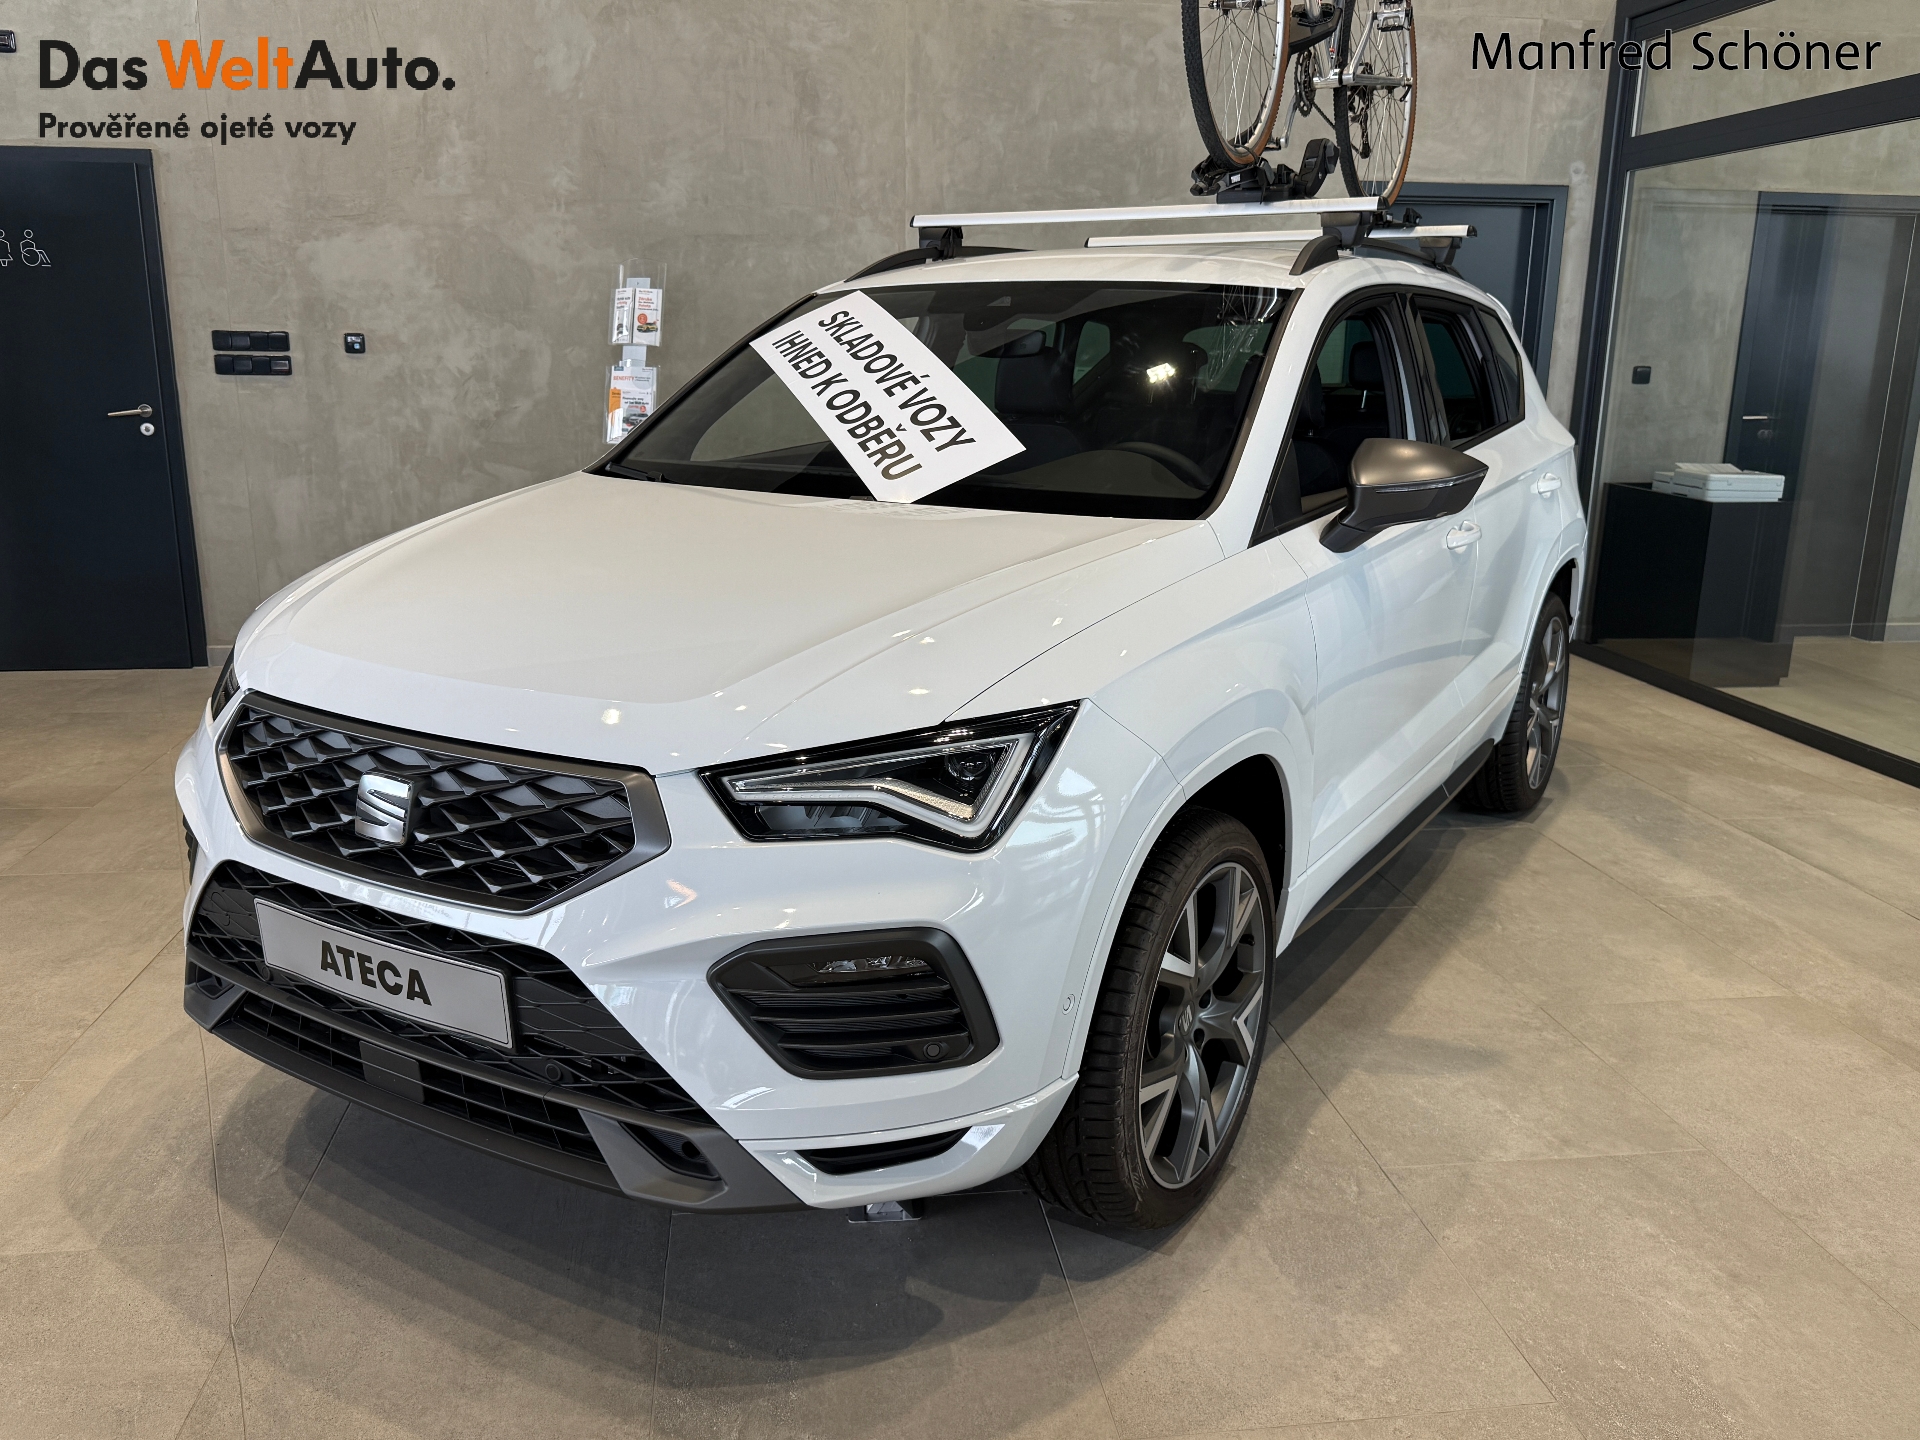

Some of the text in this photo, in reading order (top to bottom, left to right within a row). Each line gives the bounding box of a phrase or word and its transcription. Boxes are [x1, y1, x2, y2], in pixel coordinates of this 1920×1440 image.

[771, 329, 923, 481] IHNED K ODBĚRU
[818, 310, 977, 453] SKLADOVÉ VOZY
[320, 939, 433, 1007] ATECA
